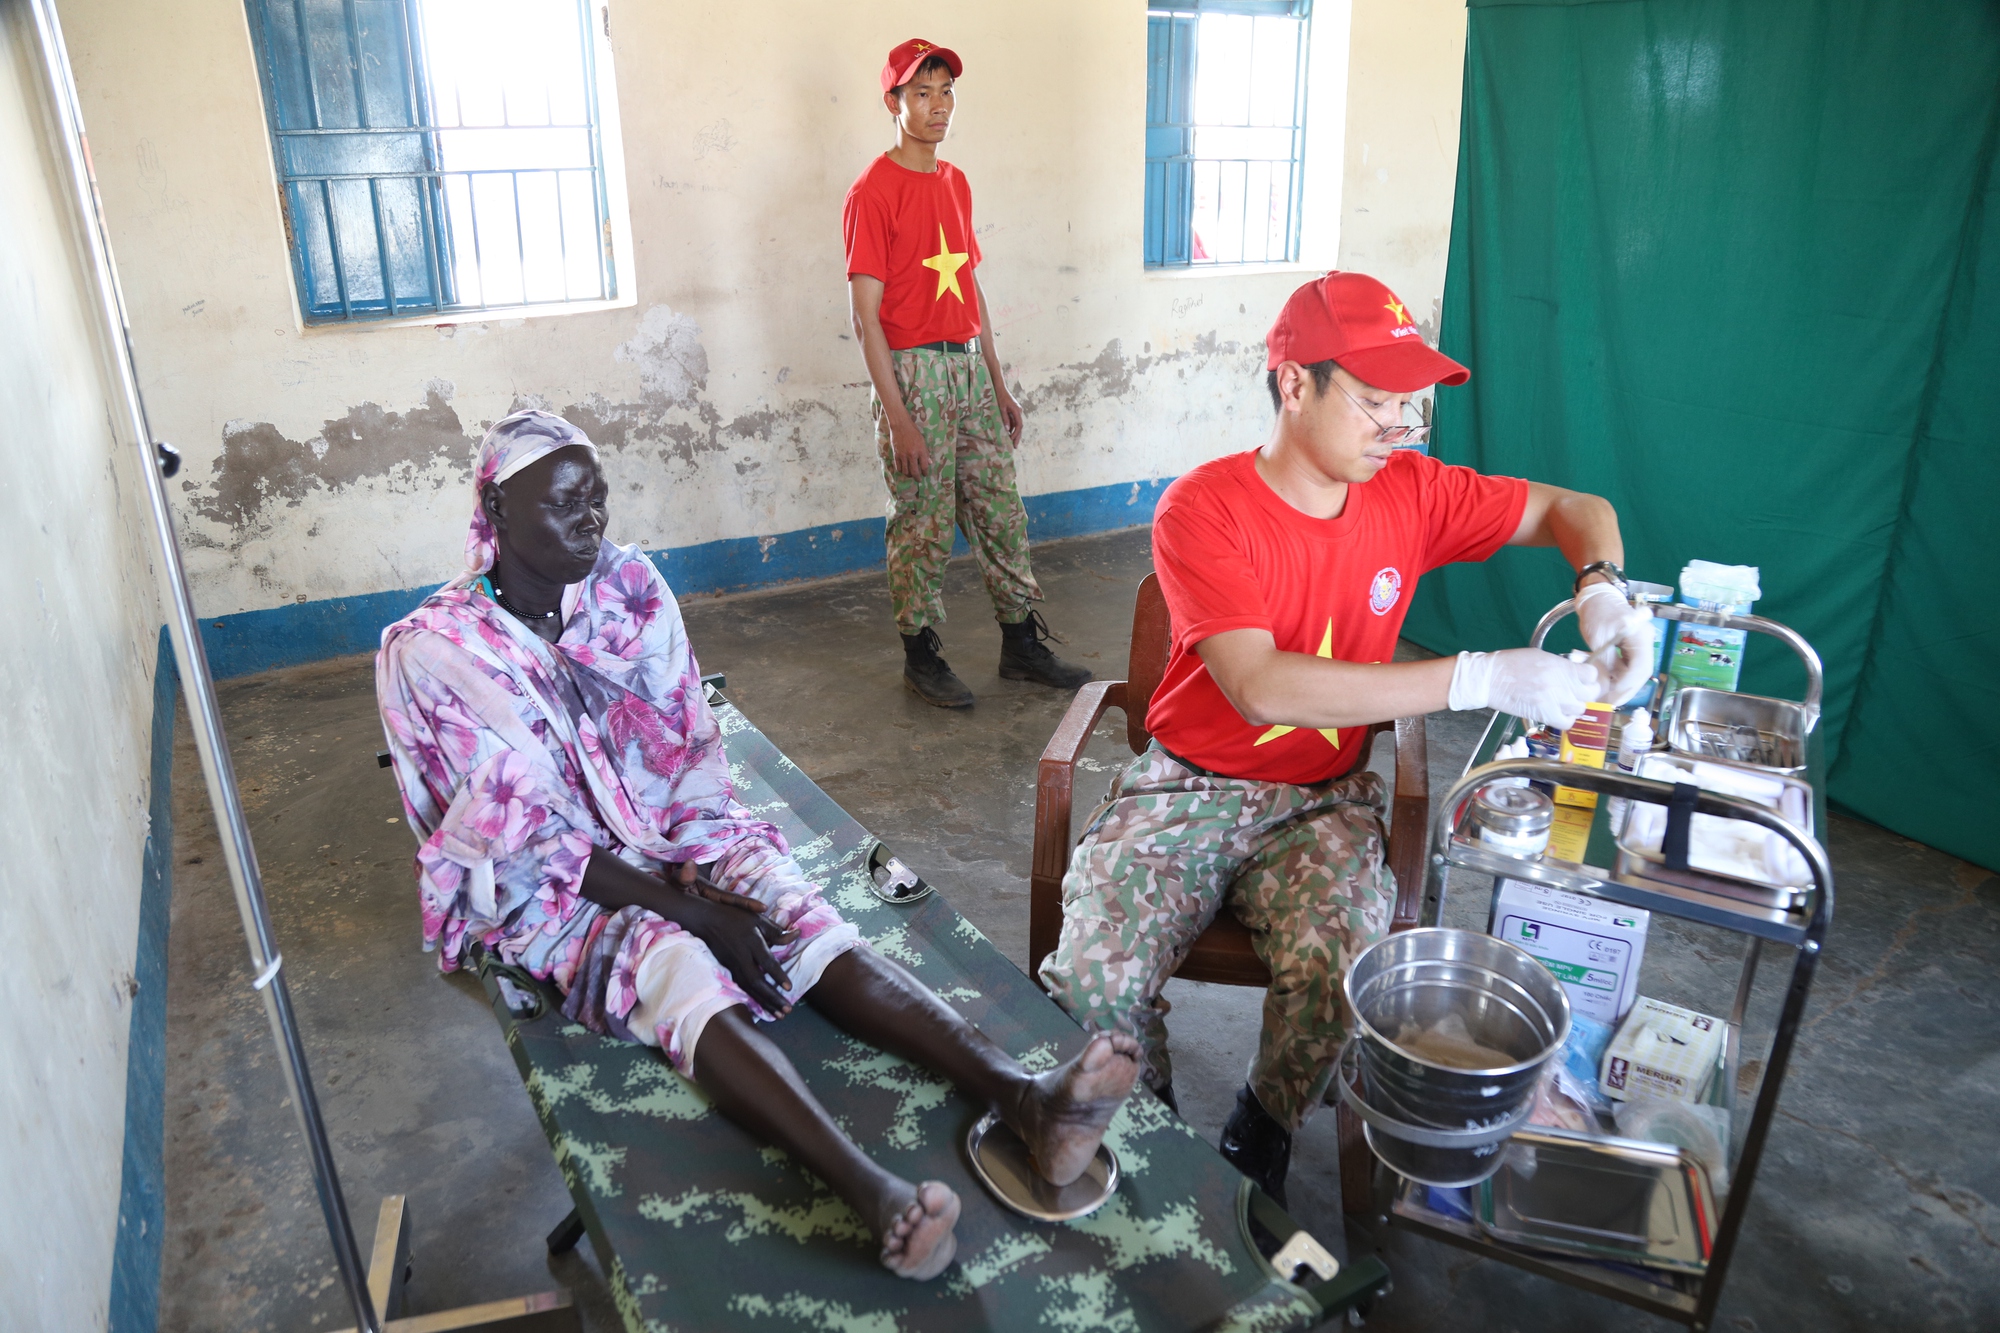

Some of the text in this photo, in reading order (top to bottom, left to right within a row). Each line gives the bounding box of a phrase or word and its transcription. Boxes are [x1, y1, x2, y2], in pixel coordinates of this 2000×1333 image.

[1536, 899, 1554, 909] USE
[1556, 904, 1588, 917] SINGLE
[1636, 1065, 1683, 1087] MERUFA
